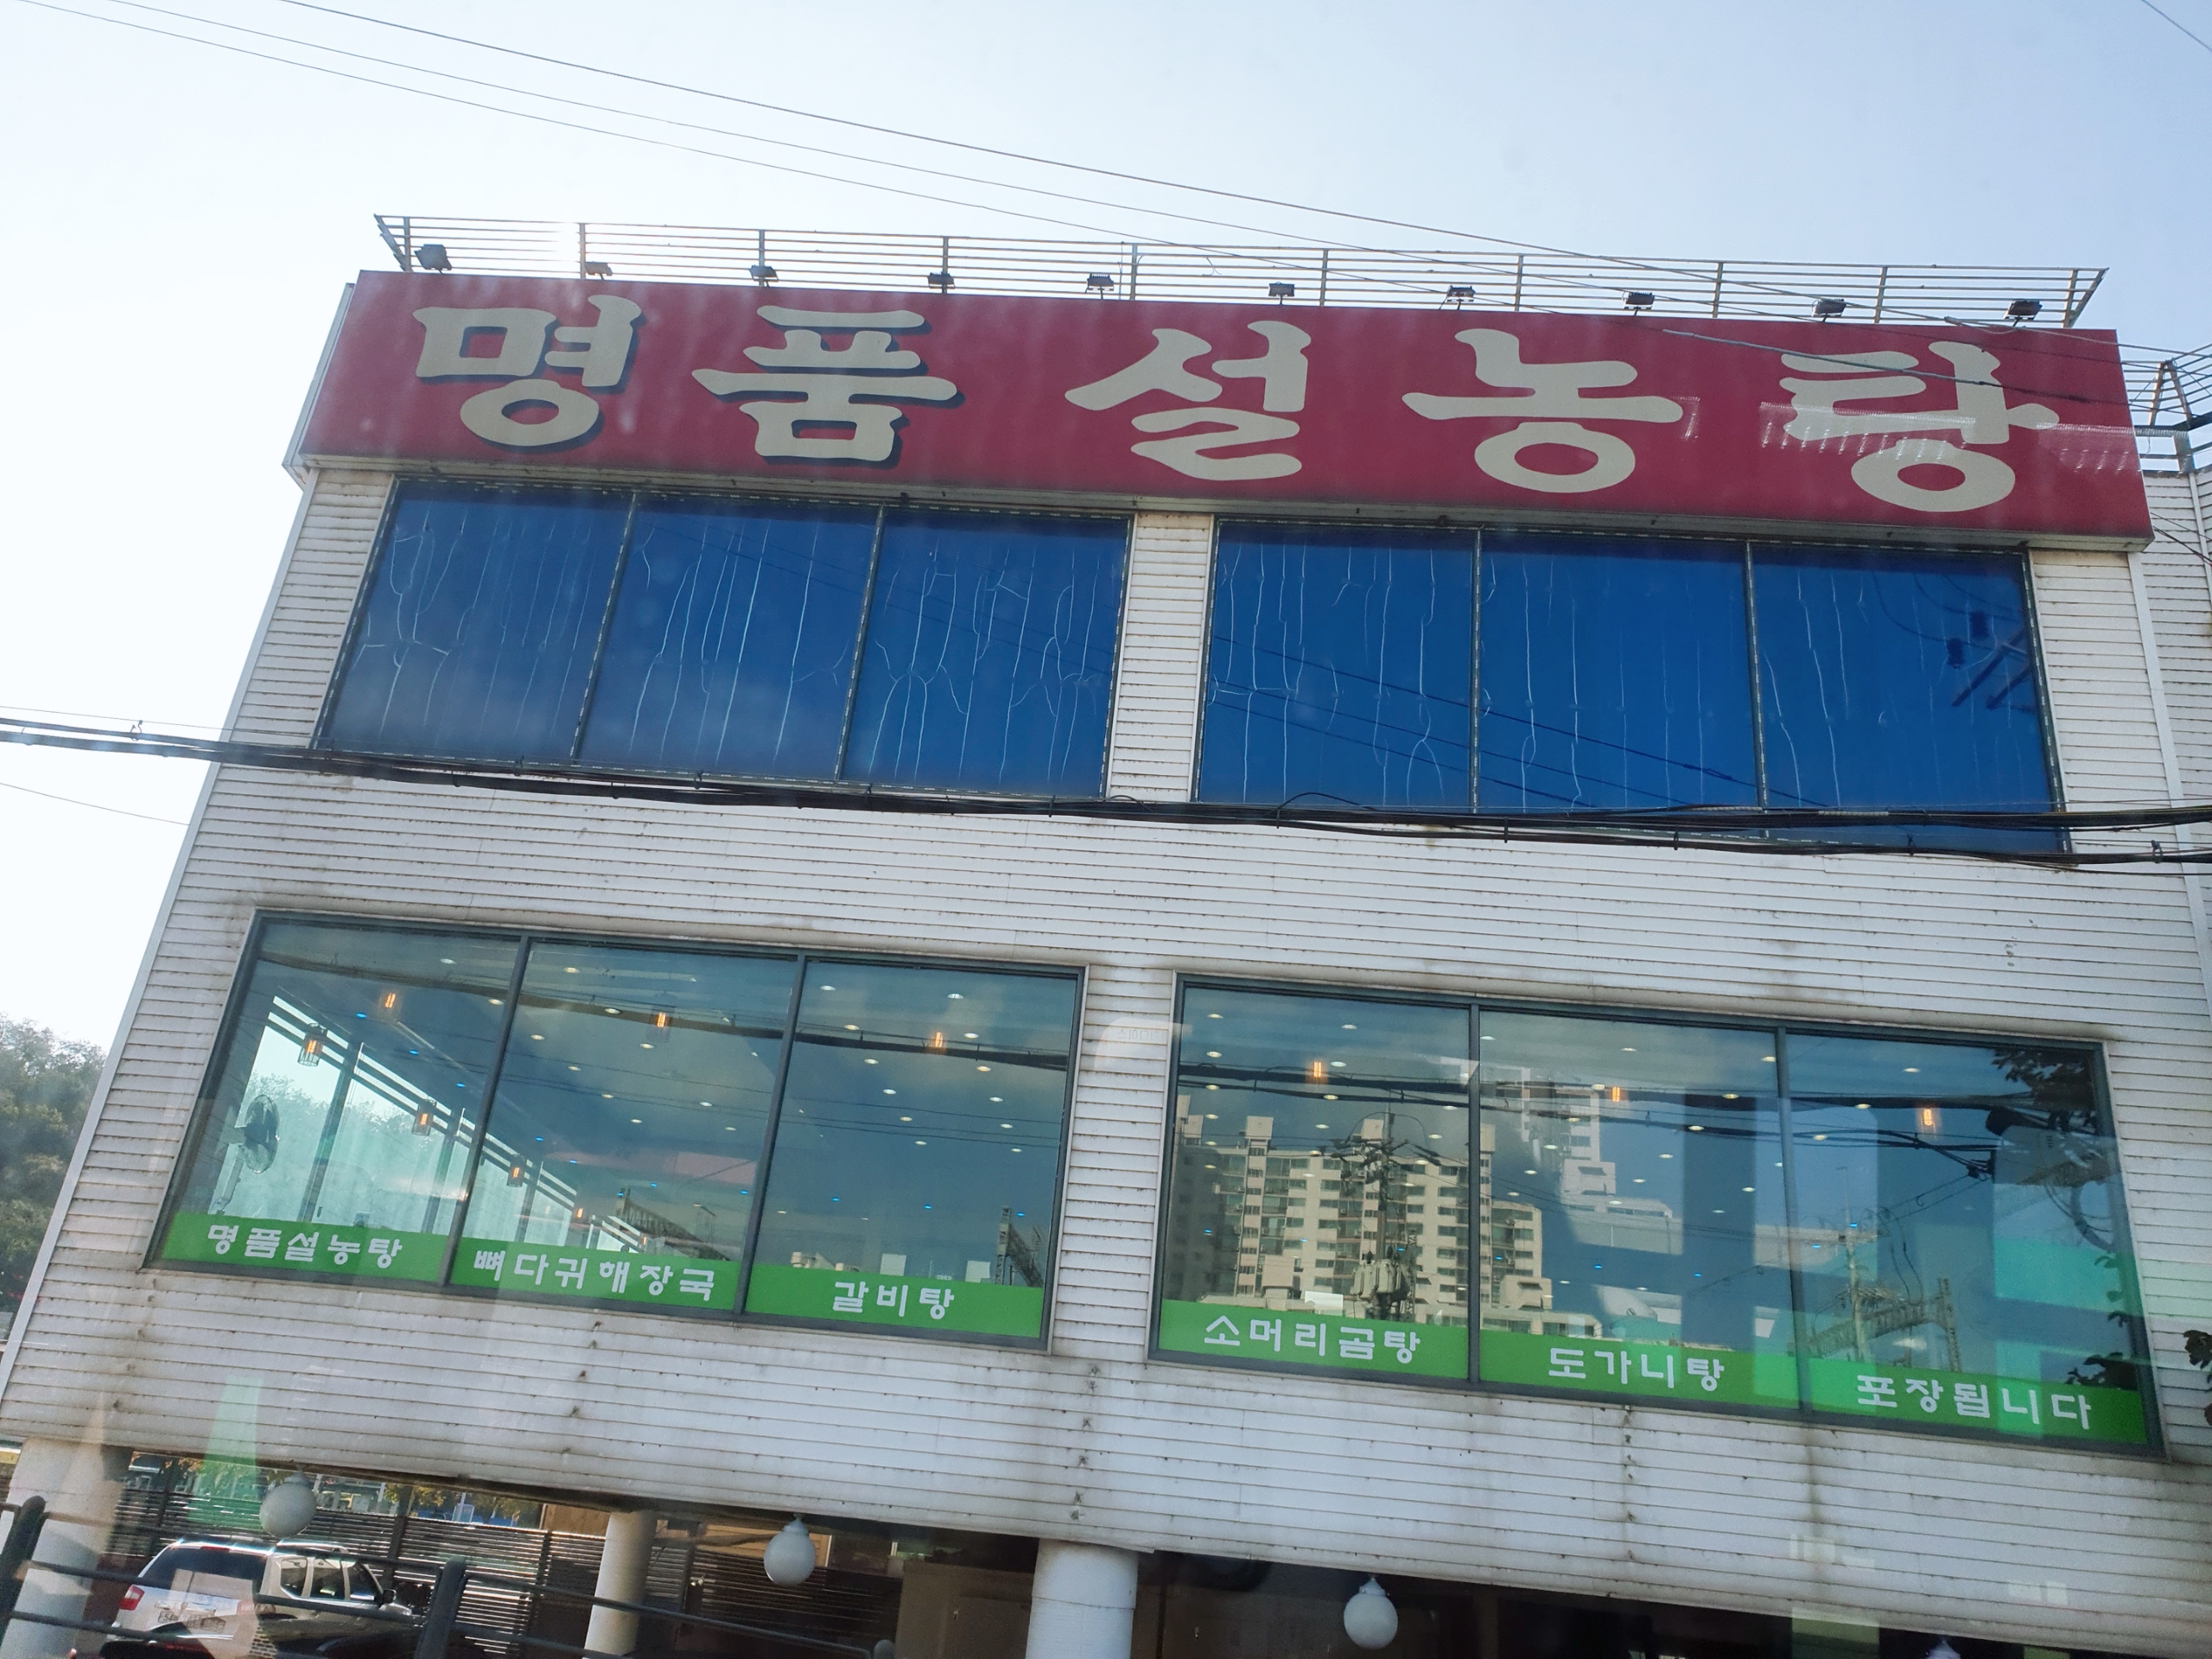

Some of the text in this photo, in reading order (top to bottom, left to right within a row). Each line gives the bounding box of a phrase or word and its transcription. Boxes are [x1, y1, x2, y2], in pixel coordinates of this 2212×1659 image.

[413, 294, 2061, 512] 명품설농탕
[207, 1224, 403, 1269] 명품설농탕
[474, 1249, 715, 1301] 뼈다귀해장국
[832, 1281, 955, 1320] 갈비탕
[1204, 1315, 1421, 1364] 소머리곰탕
[1548, 1347, 1725, 1392] 도가니탕
[1857, 1375, 2091, 1430] 포장됩니다
